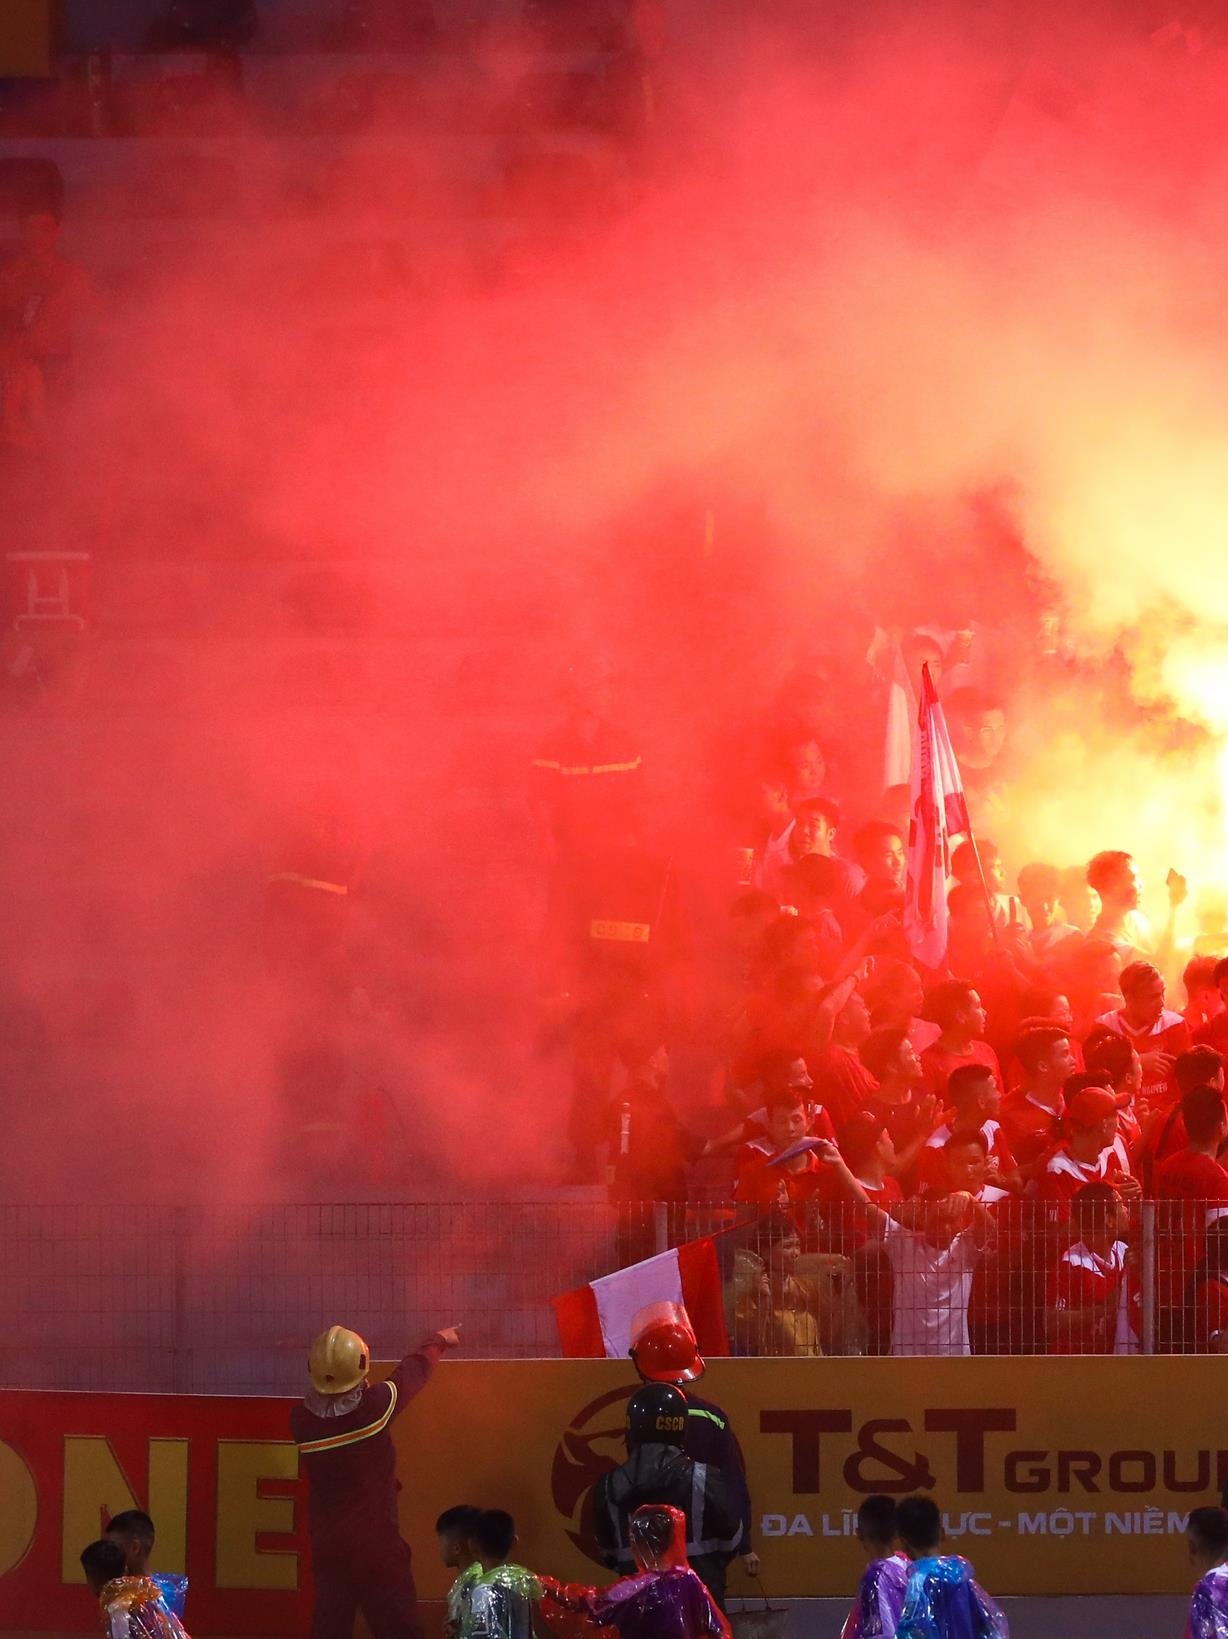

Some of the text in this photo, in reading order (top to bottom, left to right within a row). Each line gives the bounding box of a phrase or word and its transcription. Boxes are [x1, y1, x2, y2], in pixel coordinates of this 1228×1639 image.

[759, 1409, 1016, 1494] T&T
[0, 1434, 299, 1589] NE
[760, 1513, 814, 1537] ĐA
[822, 1508, 859, 1537] LĨ
[941, 1511, 993, 1540] ỰC
[1018, 1507, 1097, 1539] MỘT
[1105, 1504, 1191, 1535] NIỀM
